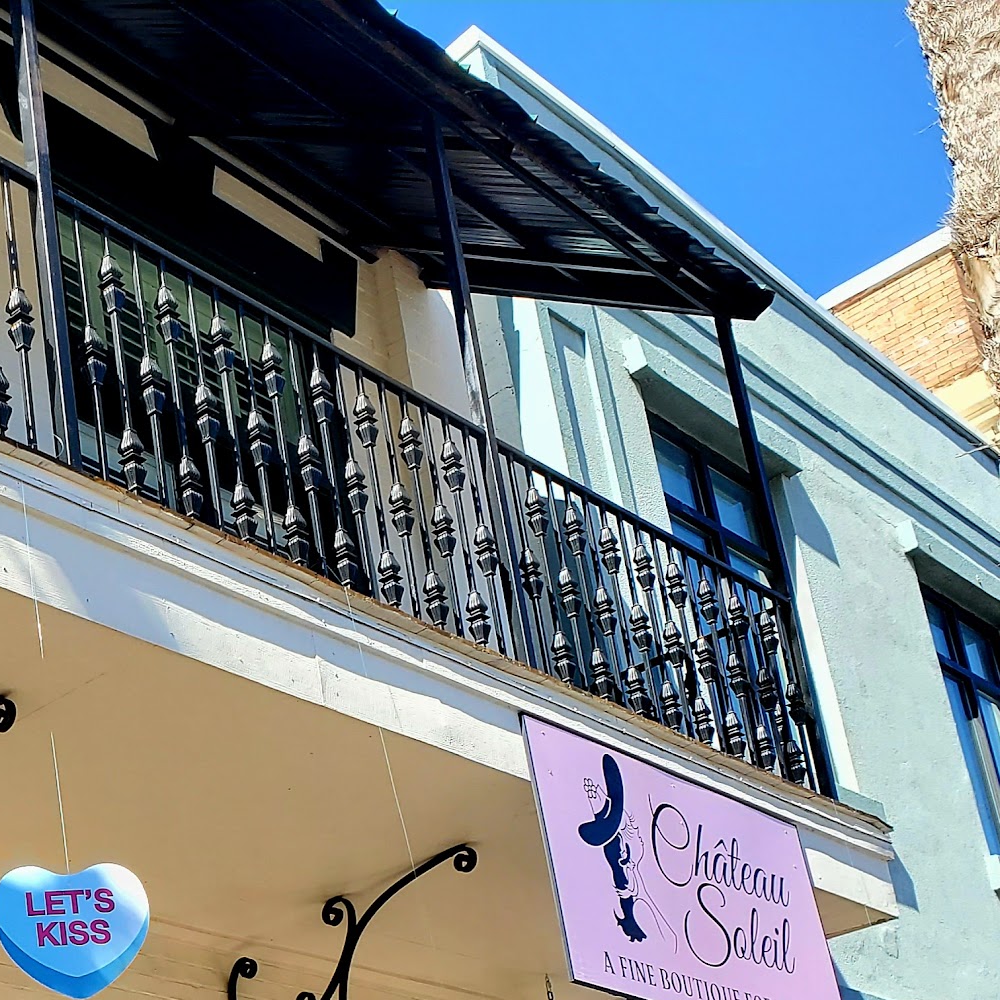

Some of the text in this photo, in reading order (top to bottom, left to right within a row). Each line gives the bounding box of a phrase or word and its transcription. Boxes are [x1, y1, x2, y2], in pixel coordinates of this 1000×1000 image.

[648, 794, 790, 907] Château
[25, 887, 116, 917] LET'S
[36, 919, 112, 948] KISS
[684, 883, 796, 974] Soleil
[603, 951, 616, 975] A
[619, 954, 657, 987] FINE
